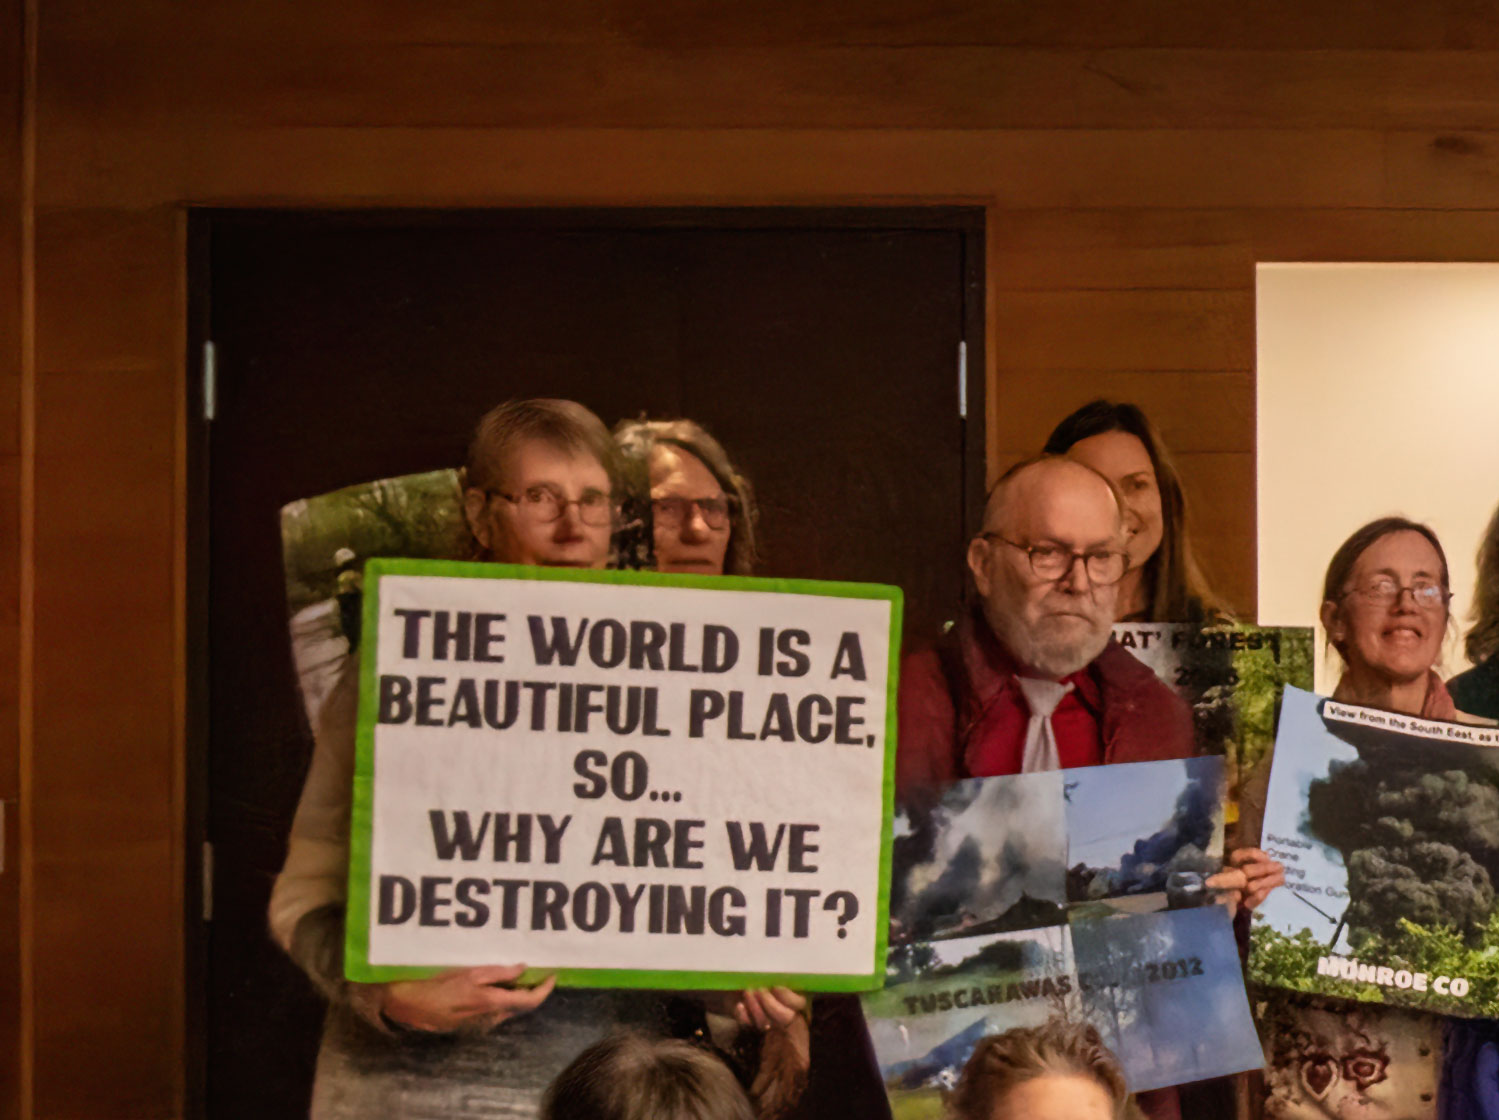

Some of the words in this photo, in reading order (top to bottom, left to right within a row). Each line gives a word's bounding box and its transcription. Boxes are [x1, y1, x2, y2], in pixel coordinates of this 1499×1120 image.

[394, 608, 506, 663] THE
[527, 615, 739, 674] WORLD
[757, 627, 810, 678] IS
[831, 631, 866, 681] A
[378, 675, 670, 737] BEAUTIFUL
[688, 689, 876, 750] PLACE,
[1329, 706, 1356, 718] View
[1360, 711, 1386, 724] from
[1389, 718, 1406, 729] the
[1410, 721, 1443, 735] South
[573, 750, 681, 802] SO...
[428, 810, 573, 864] WHY
[592, 816, 705, 868] ARE
[726, 821, 820, 872] WE
[378, 875, 746, 936] DESTROYING
[764, 888, 859, 939] IT?
[904, 975, 1072, 1015] TUSCARAWAS
[1317, 956, 1427, 992] MONROE
[1432, 976, 1469, 997] CO
